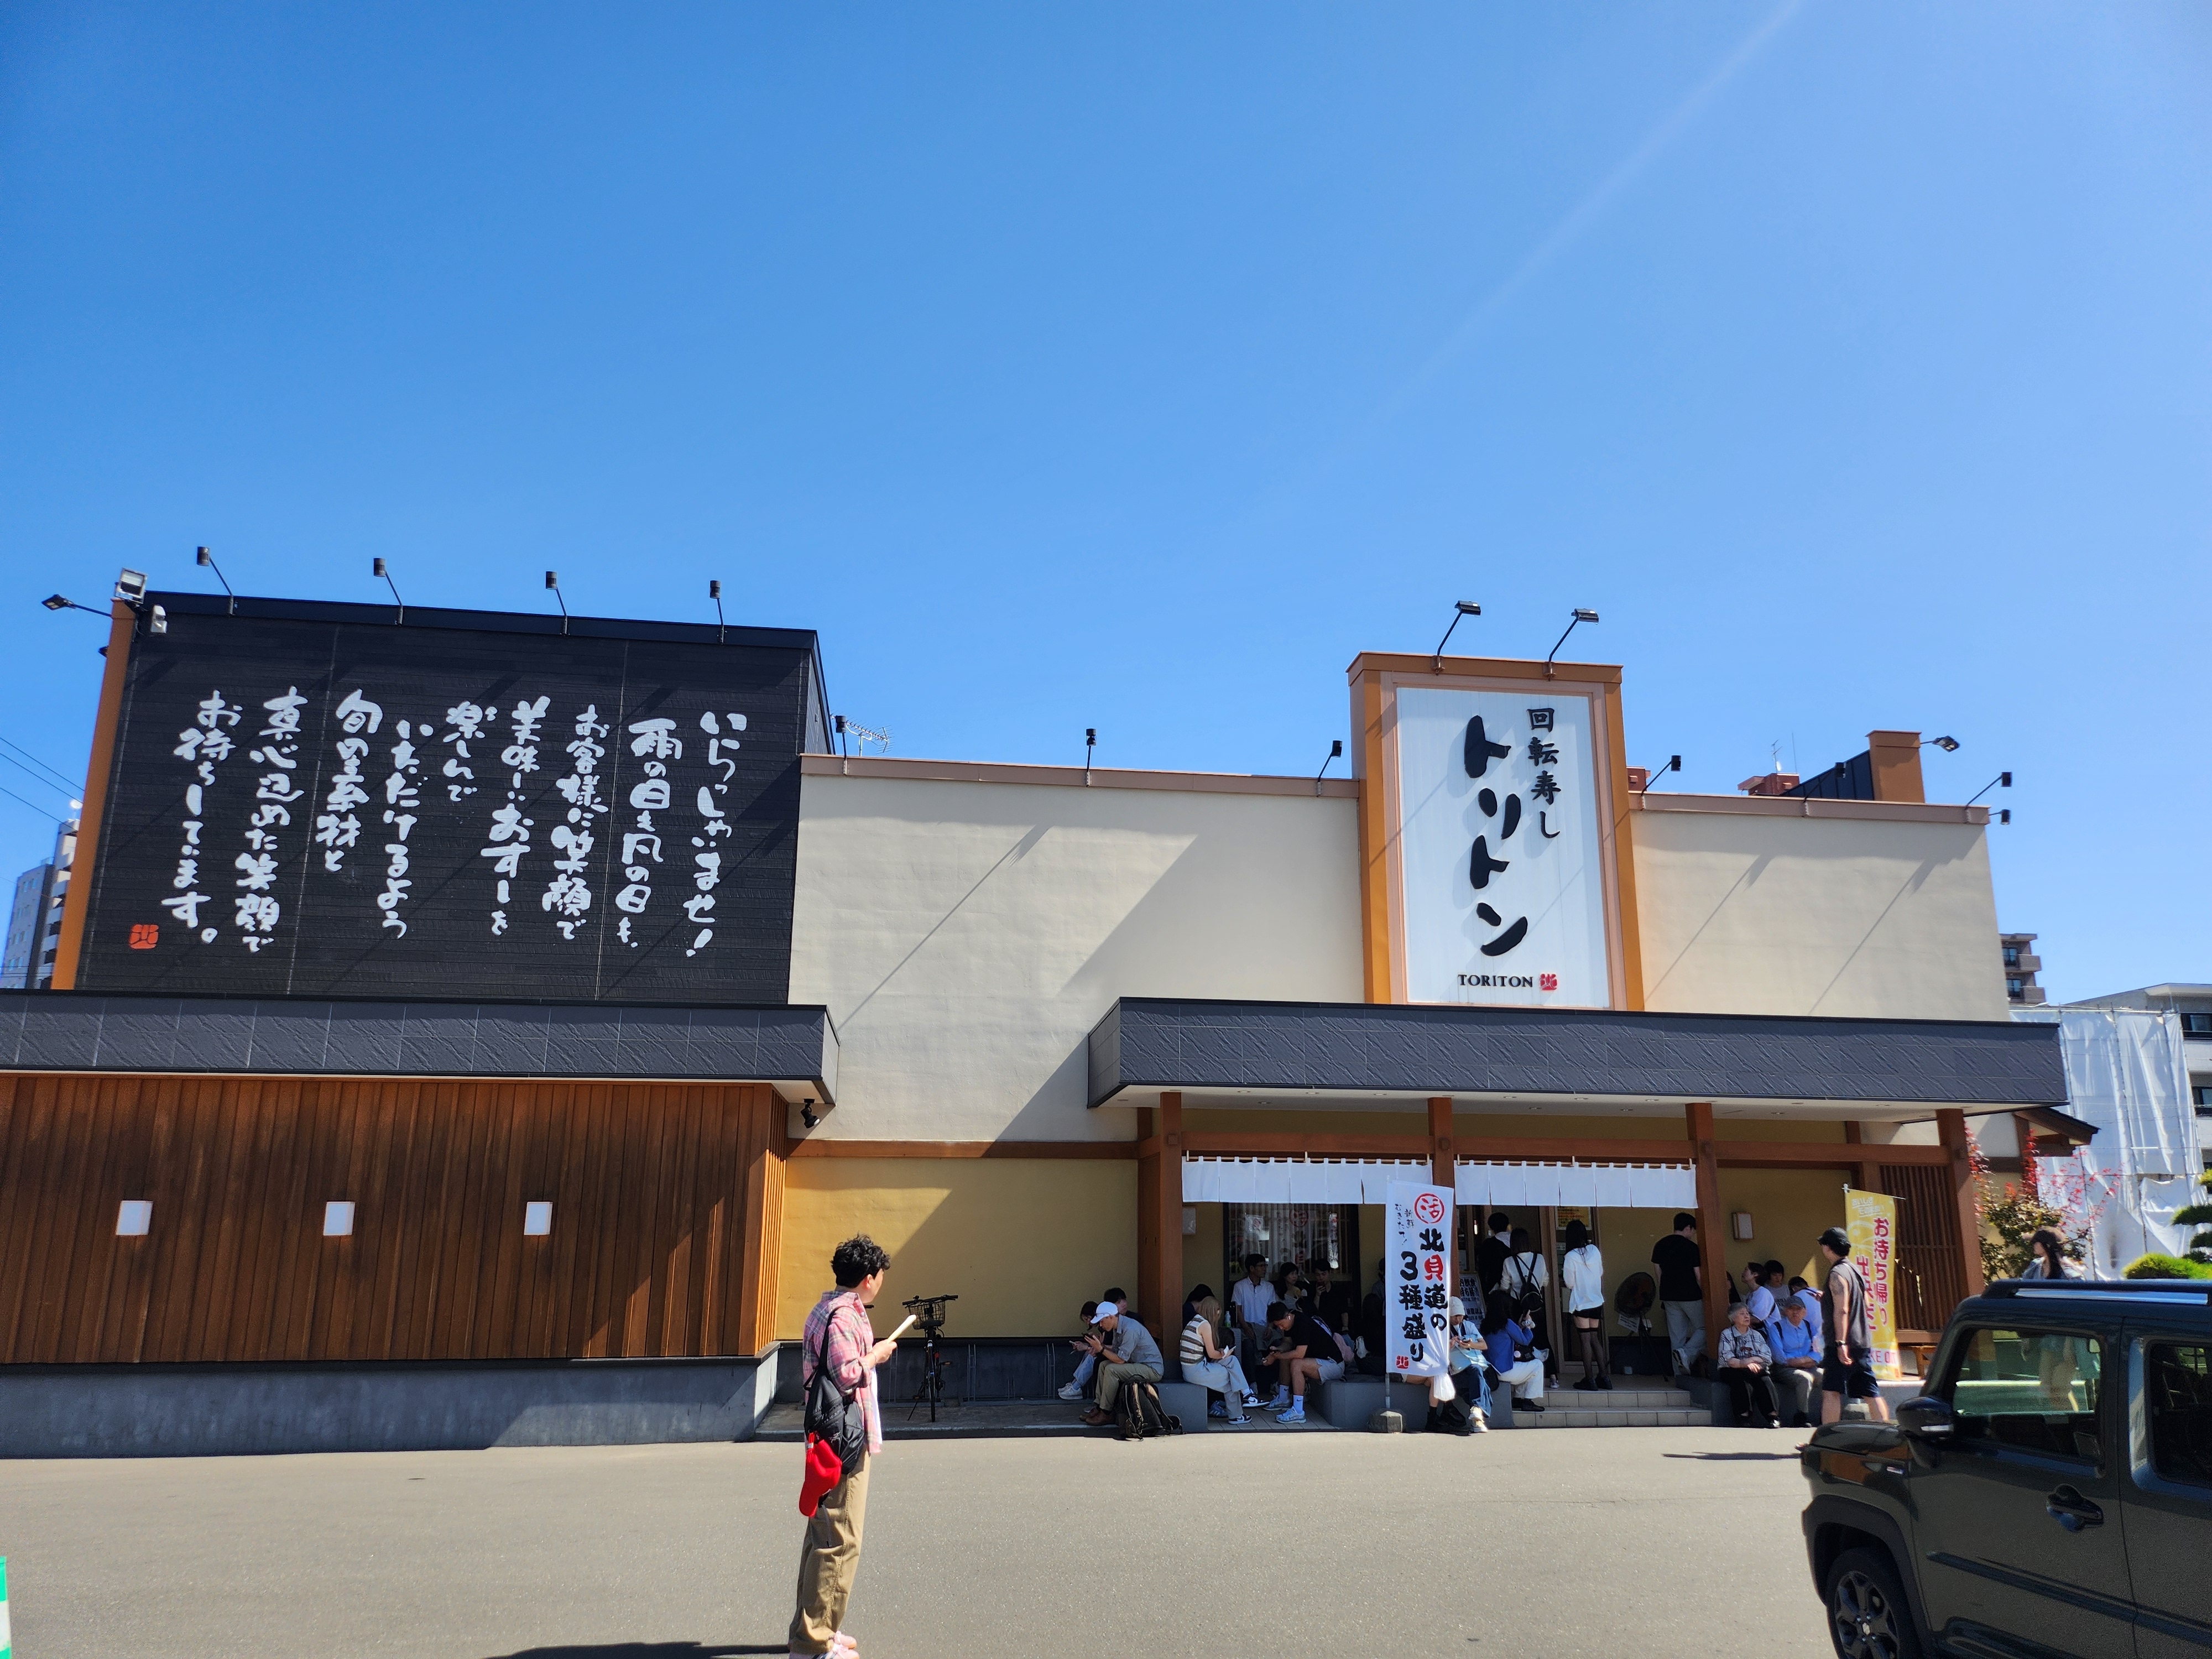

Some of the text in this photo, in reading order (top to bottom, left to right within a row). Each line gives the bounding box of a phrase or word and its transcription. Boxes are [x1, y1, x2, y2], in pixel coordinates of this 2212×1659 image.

[161, 690, 242, 943] お待ちしています。
[236, 686, 307, 952] 真心込めた笑顔で
[316, 689, 383, 872] 旬の素材と
[378, 719, 433, 938] いただけるよう
[443, 701, 497, 801] 楽しんで
[481, 696, 550, 935] 美味しいおすしを
[541, 704, 609, 940] お客様に笑顔で
[1464, 715, 1528, 956] トリトン
[1527, 708, 1561, 838] 回転寿し
[1458, 974, 1533, 988] TORITON
[1399, 1251, 1427, 1361] 3種盛り
[1419, 1228, 1448, 1331] 北貝道の
[1872, 1217, 1890, 1326] お持ち帰り
